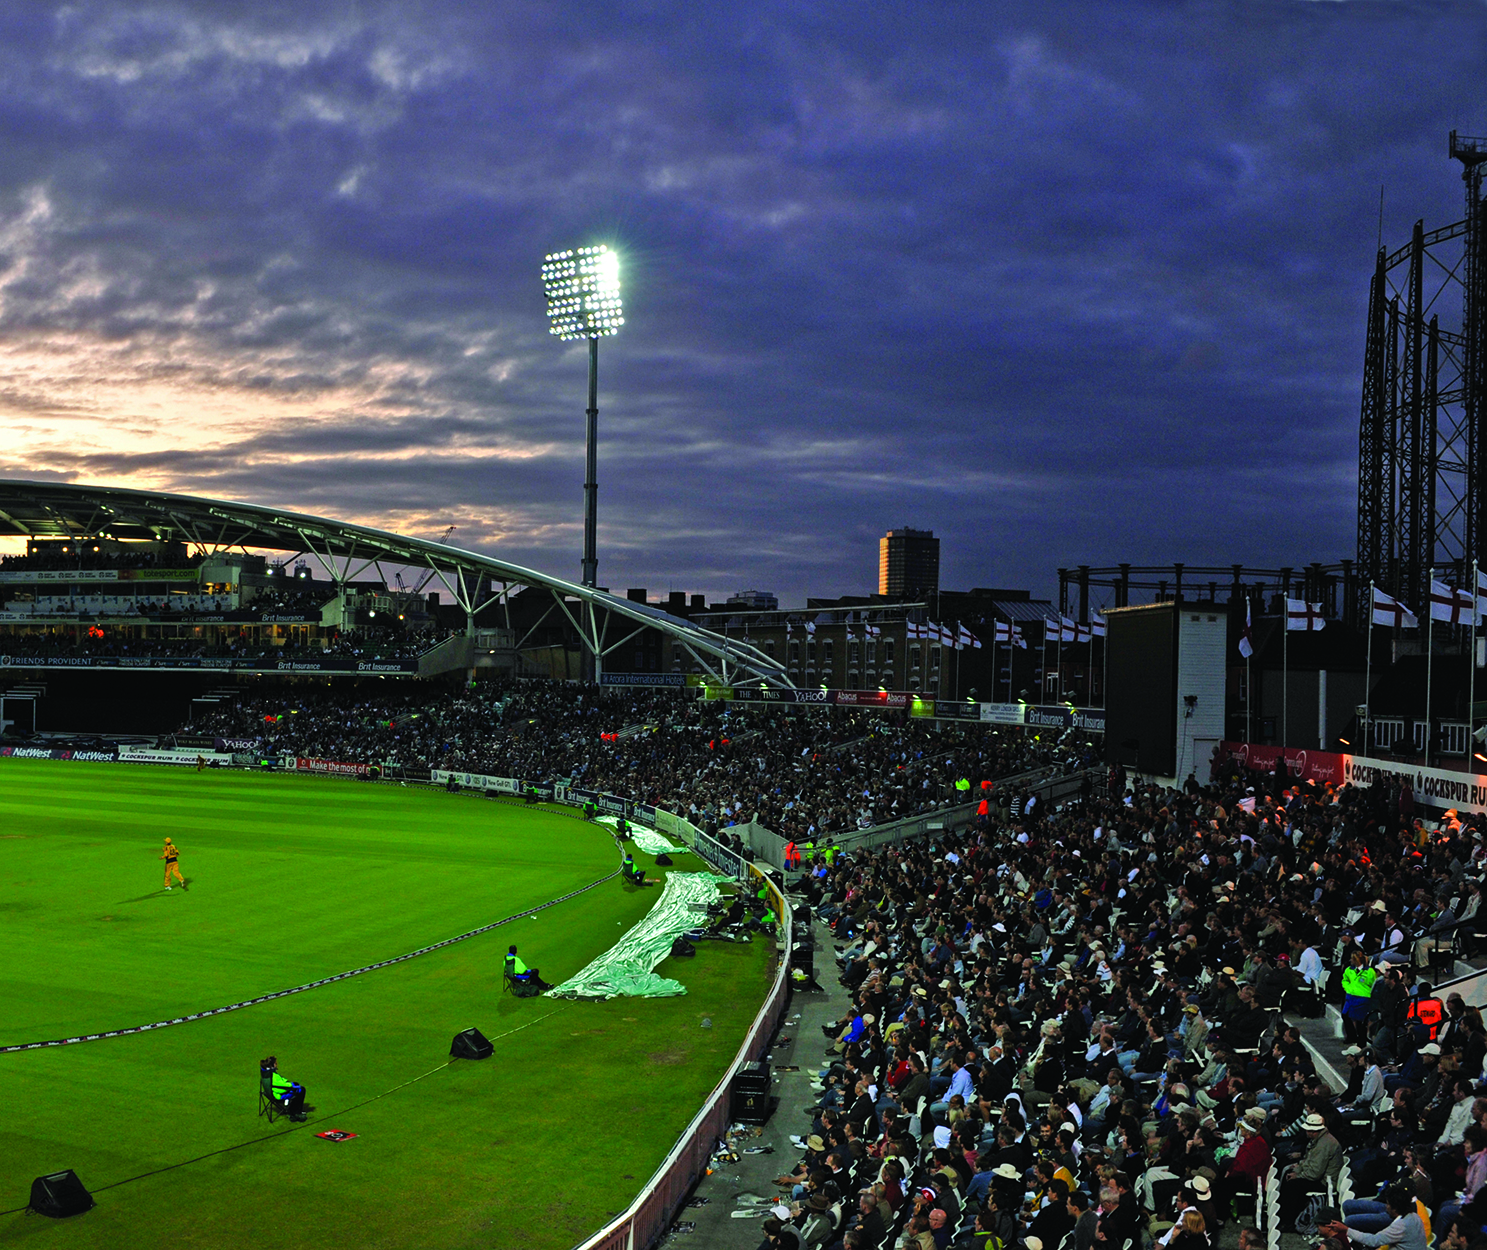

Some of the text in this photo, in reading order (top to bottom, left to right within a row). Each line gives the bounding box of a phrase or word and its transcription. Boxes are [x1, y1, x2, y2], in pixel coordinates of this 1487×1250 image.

[143, 570, 195, 579] totesport.com
[278, 661, 292, 669] Brit
[358, 662, 373, 670] Brit
[609, 674, 685, 684] Arora International Hotels
[794, 691, 828, 702] YAHOO!
[837, 692, 857, 700] Abacus
[887, 694, 906, 702] Abacus
[1030, 710, 1064, 725] Brit Insurance
[1073, 713, 1084, 726] Brit
[12, 748, 52, 757] NatWest
[72, 751, 114, 760] NatWest
[310, 760, 365, 773] Make the most of
[599, 798, 622, 810] Brit Insurance
